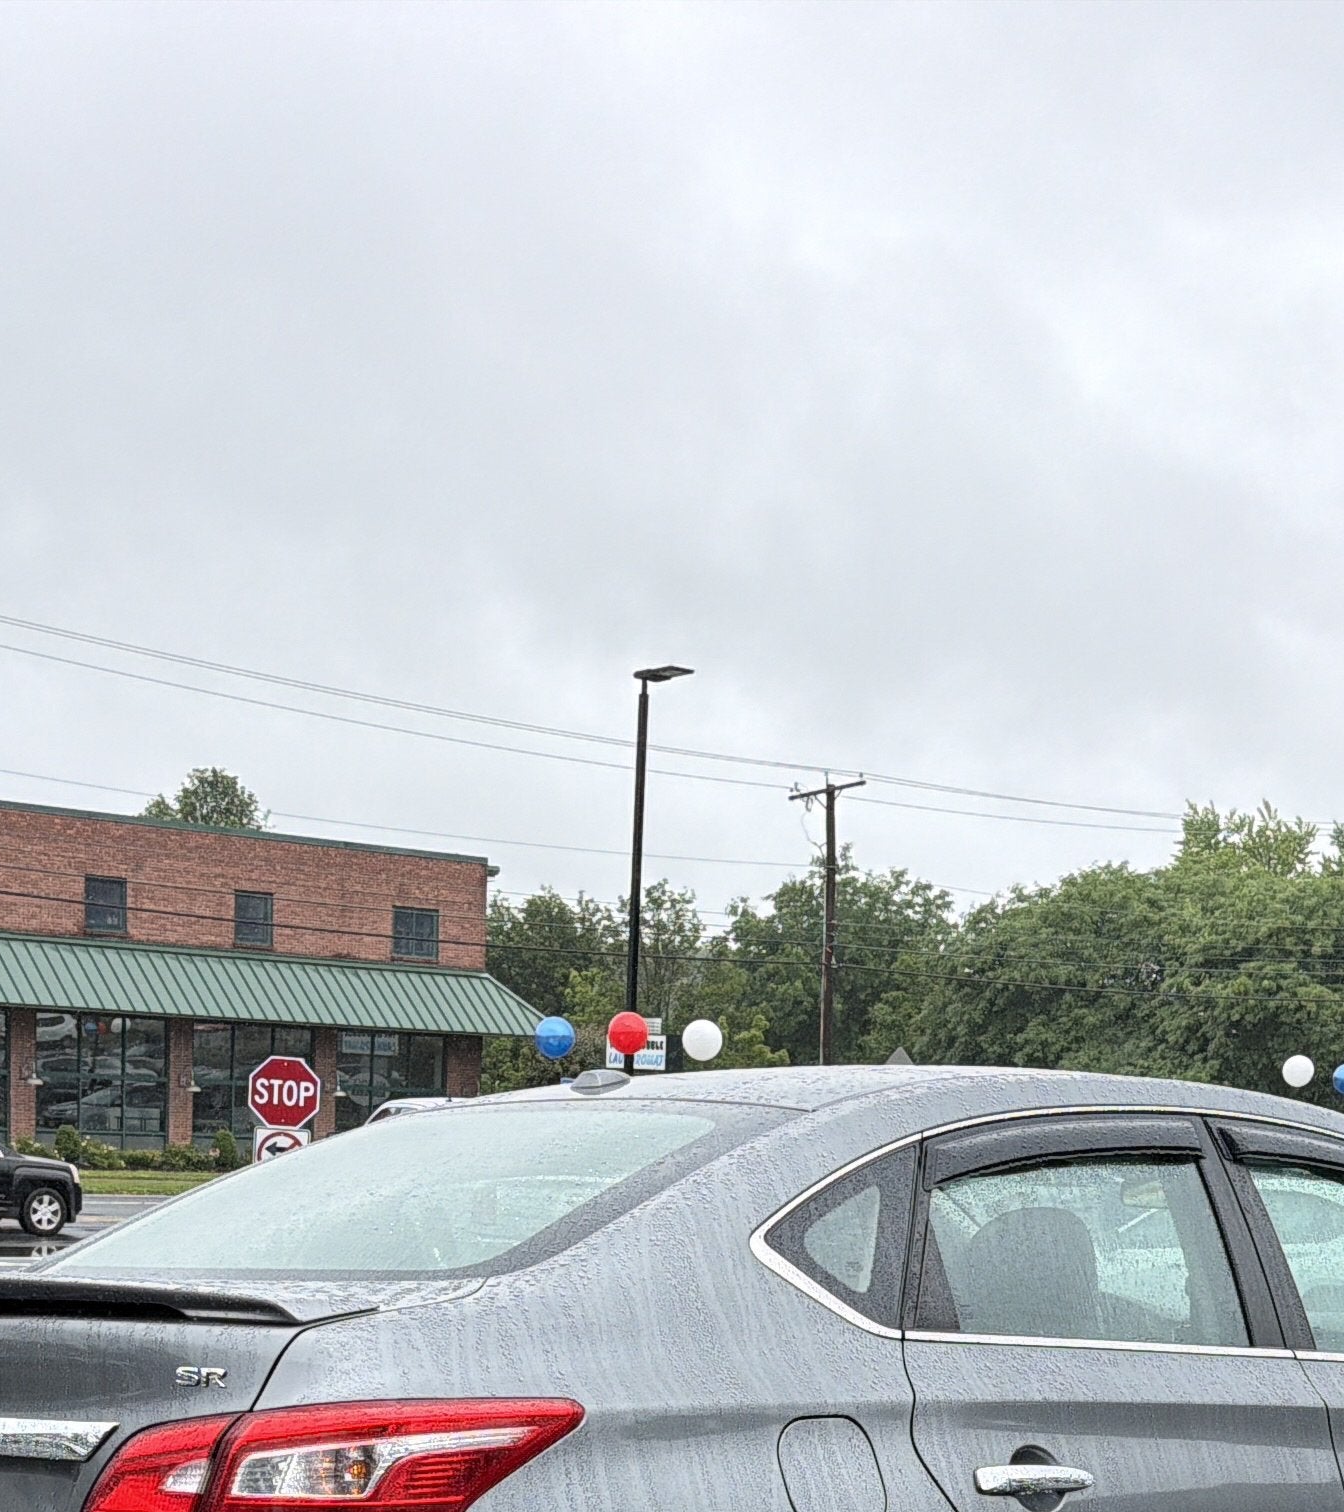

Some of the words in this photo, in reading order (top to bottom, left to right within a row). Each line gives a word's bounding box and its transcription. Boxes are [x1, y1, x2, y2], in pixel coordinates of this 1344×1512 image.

[608, 1053, 663, 1066] LAUROMAT
[254, 1077, 315, 1107] STOP
[176, 1366, 227, 1388] SR
